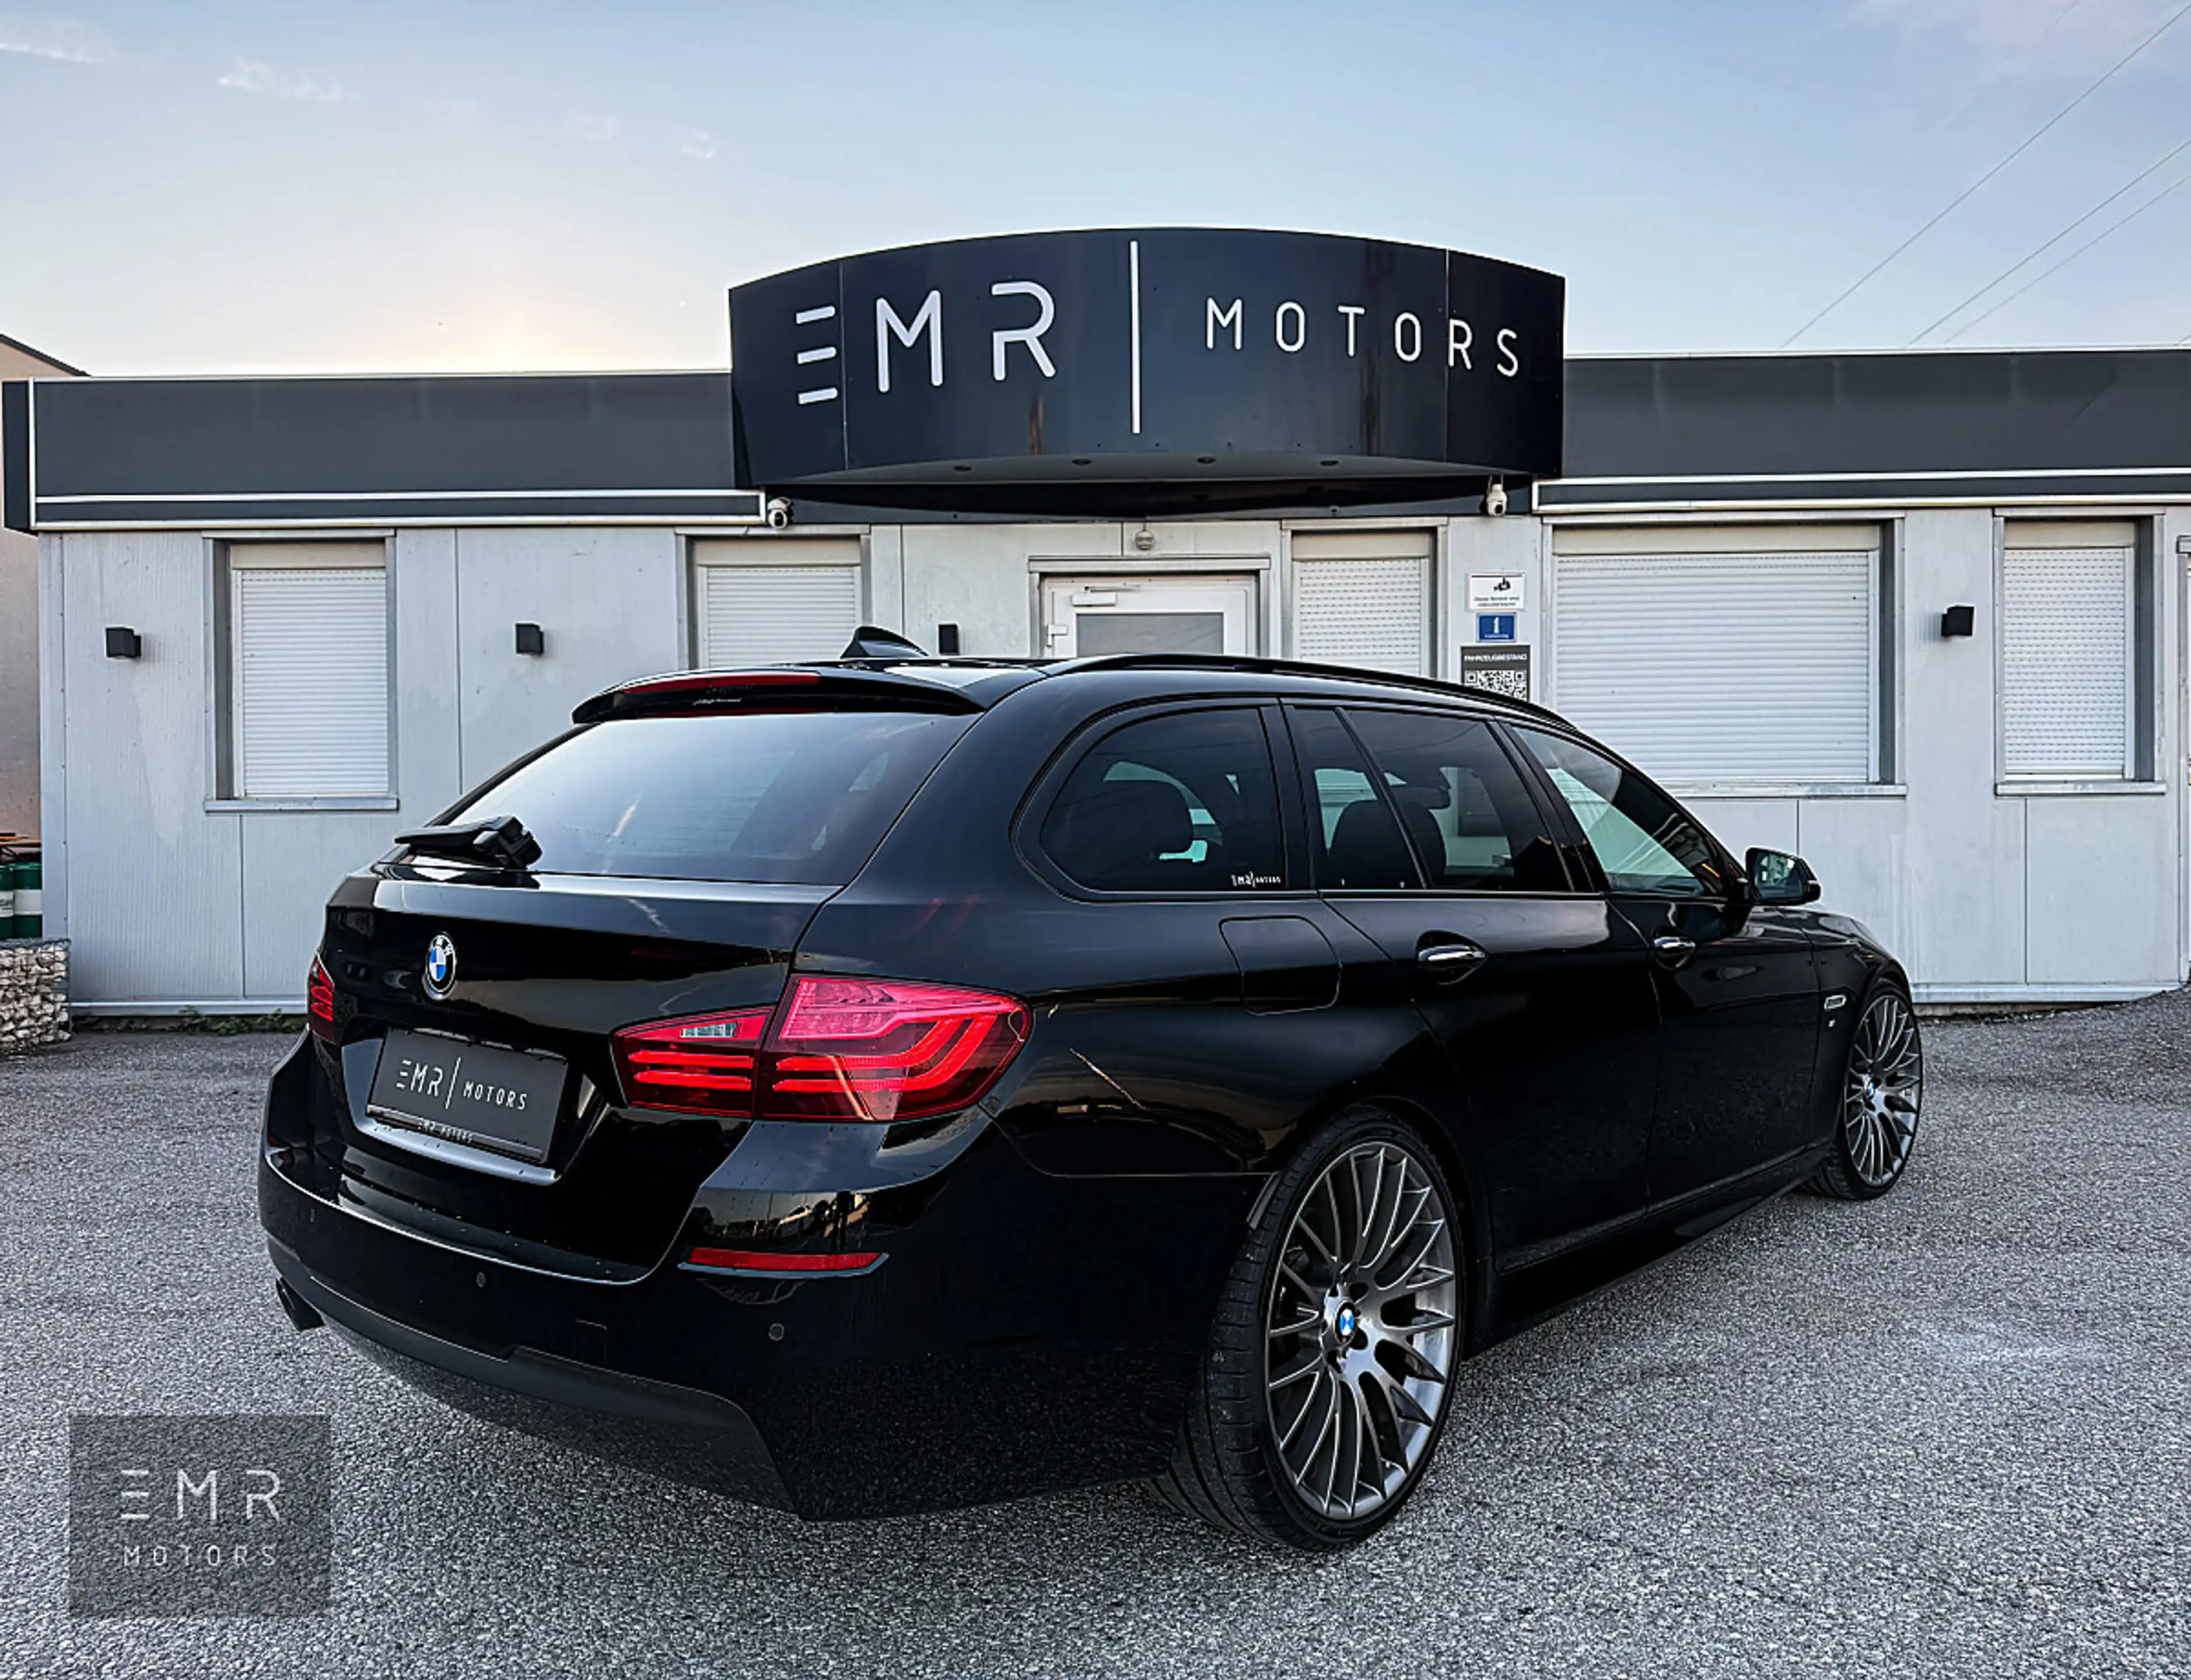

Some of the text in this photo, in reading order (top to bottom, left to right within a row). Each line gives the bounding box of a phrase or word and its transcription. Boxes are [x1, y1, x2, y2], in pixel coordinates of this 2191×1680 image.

[795, 281, 1519, 405] EMR MOTORS
[1493, 616, 1500, 634] 1
[396, 1059, 527, 1110] EMR MOTORS
